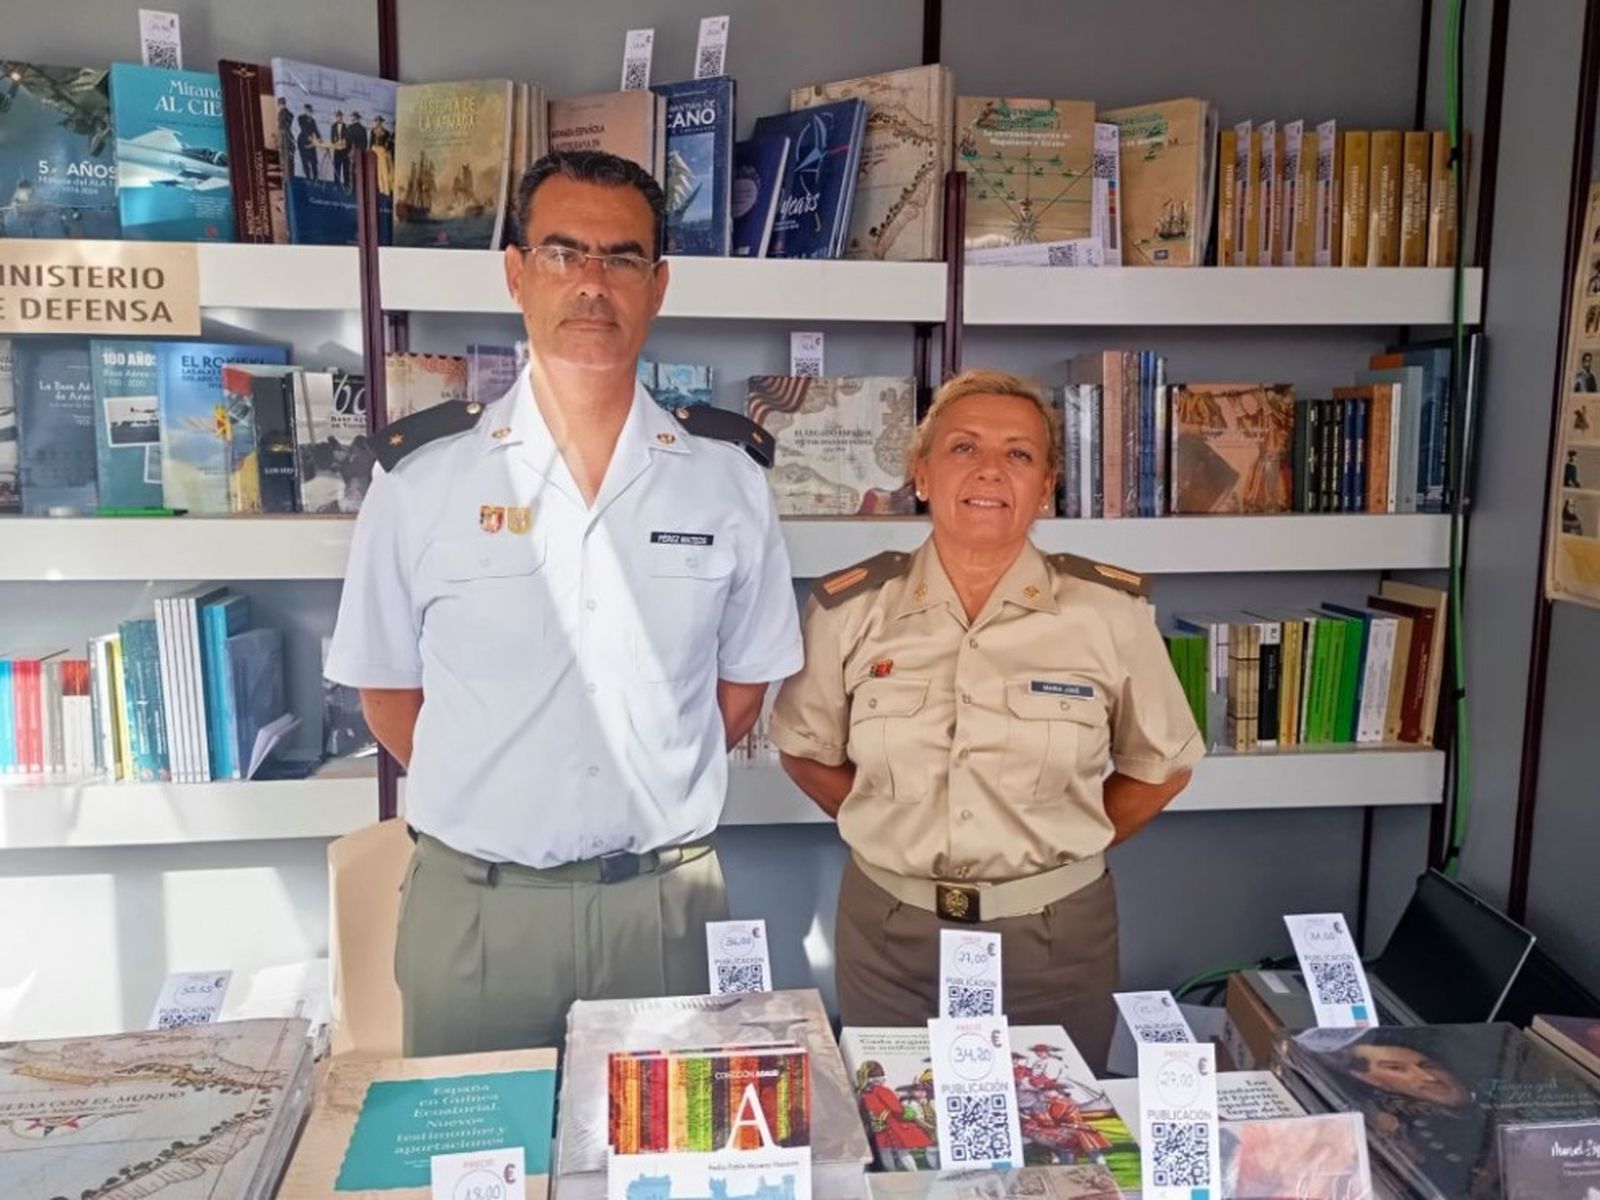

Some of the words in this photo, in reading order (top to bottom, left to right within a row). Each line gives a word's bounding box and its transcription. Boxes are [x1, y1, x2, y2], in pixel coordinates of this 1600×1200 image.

[155, 96, 183, 113] AL
[187, 99, 223, 117] CIE
[66, 160, 116, 179] AÑOS
[19, 298, 173, 323] DEFENSA
[102, 351, 126, 367] 100
[181, 355, 199, 369] EL
[78, 380, 91, 391] Aé
[987, 942, 996, 957] €
[991, 1030, 1003, 1048] €
[1197, 1057, 1209, 1076] €
[433, 1084, 490, 1096] España
[941, 1080, 1009, 1094] PUBLICACIÓN
[92, 1097, 113, 1106] EL
[116, 1092, 186, 1104] MUNDO
[419, 1099, 439, 1107] en
[442, 1094, 499, 1106] Guinea
[413, 1102, 501, 1118] Ecuatorial.
[719, 1082, 783, 1152] A
[1147, 1108, 1212, 1121] PUBLICACIÓN
[427, 1118, 485, 1129] Nuevos
[396, 1128, 496, 1143] testimonios
[393, 1138, 505, 1155] aportaciones
[503, 1163, 516, 1184] €
